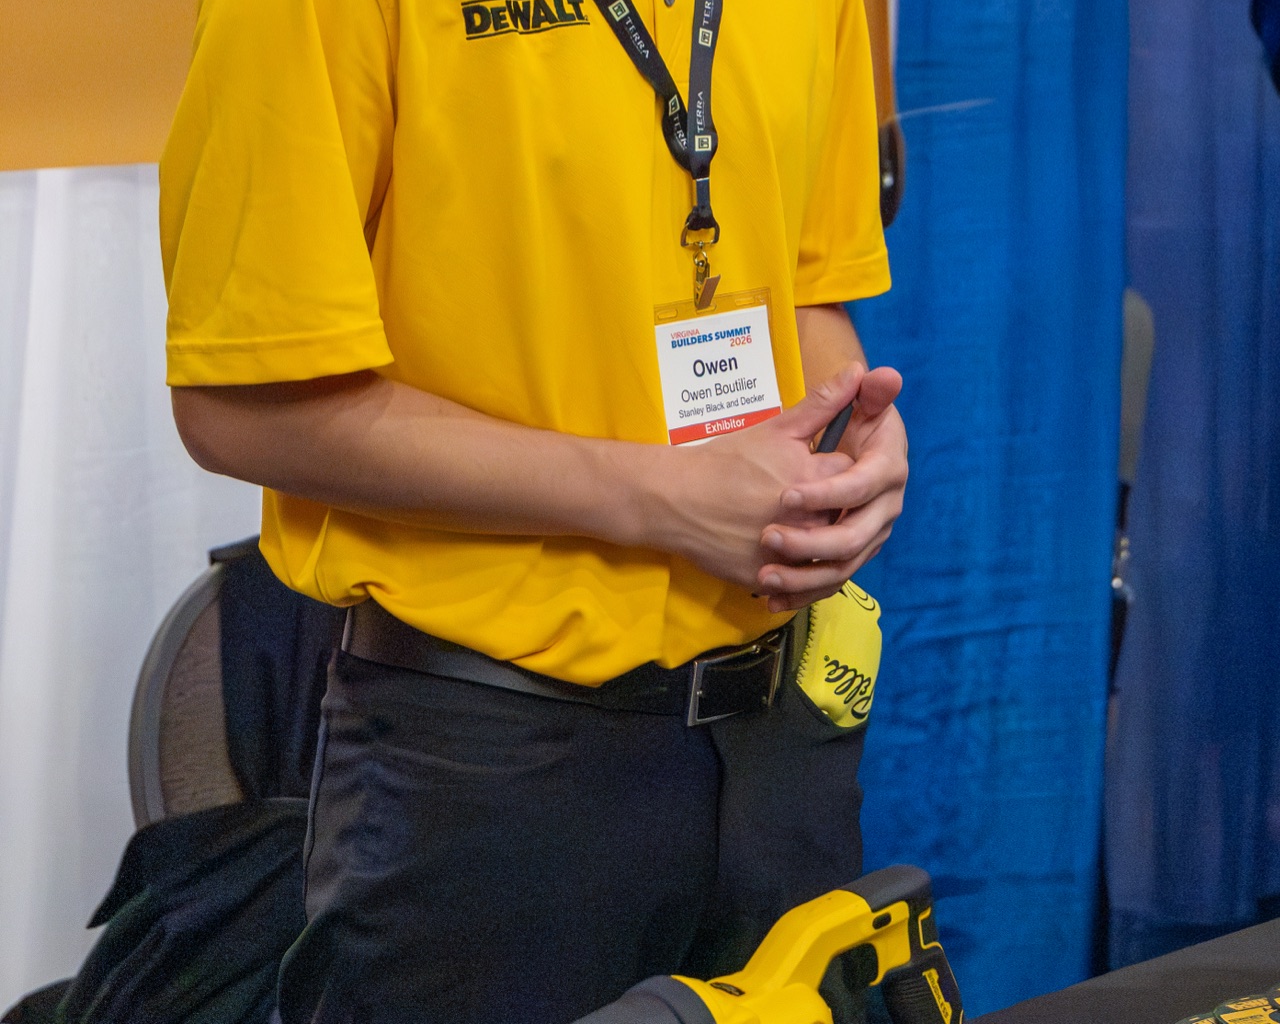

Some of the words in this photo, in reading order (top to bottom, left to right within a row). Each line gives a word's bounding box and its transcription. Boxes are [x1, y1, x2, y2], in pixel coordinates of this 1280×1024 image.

[625, 17, 650, 59] TERRA
[696, 91, 704, 132] TERRA
[670, 328, 700, 339] VIRGINIA
[671, 332, 713, 349] BUILDERS
[714, 326, 751, 341] SUMMIT
[730, 335, 752, 347] 2026
[693, 356, 738, 377] Owen
[681, 387, 712, 403] Owen
[714, 377, 757, 396] Boutilier
[678, 406, 704, 419] Stanley
[706, 400, 725, 413] Black
[726, 397, 739, 408] and
[741, 393, 765, 405] Decker
[705, 418, 745, 434] Exhibitor
